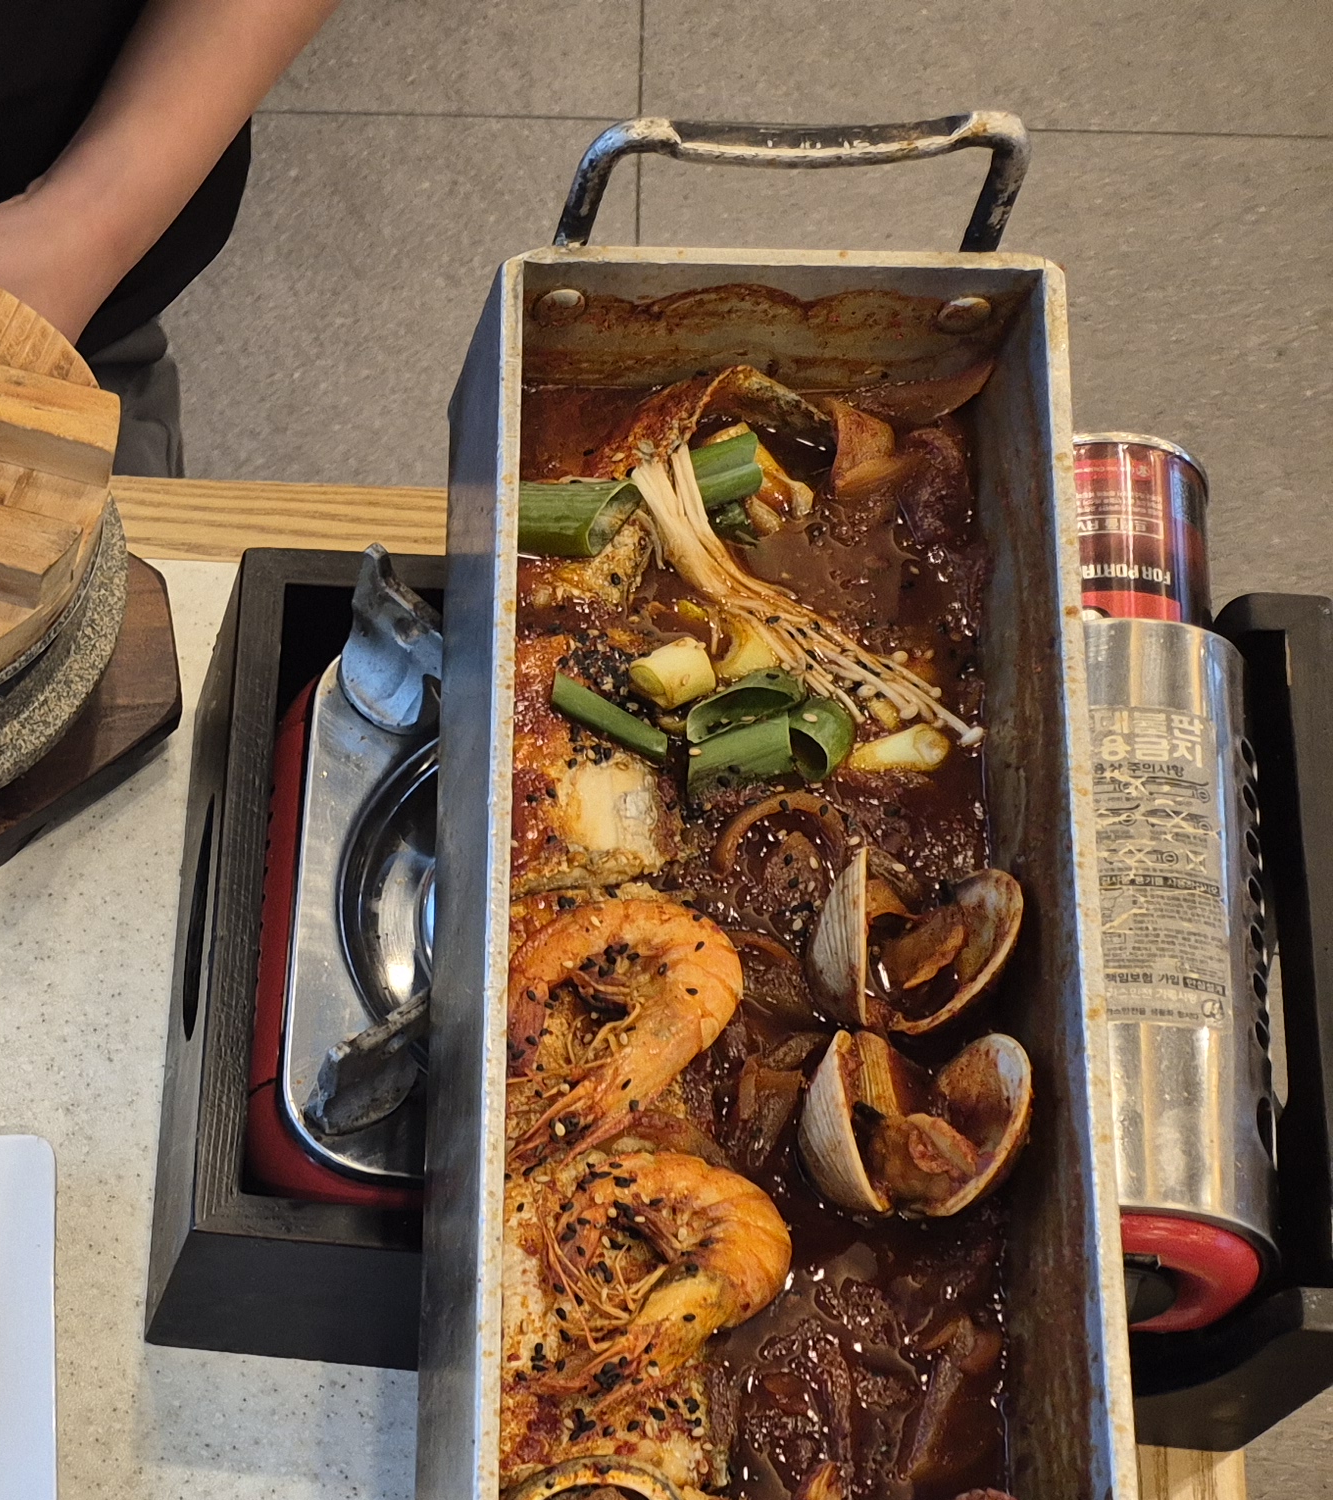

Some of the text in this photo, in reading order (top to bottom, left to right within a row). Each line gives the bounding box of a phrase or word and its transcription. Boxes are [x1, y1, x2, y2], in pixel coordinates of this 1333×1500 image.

[1080, 563, 1171, 585] FOR PORTA
[1127, 761, 1185, 778] 주의사항
[1157, 973, 1180, 986] 가입
